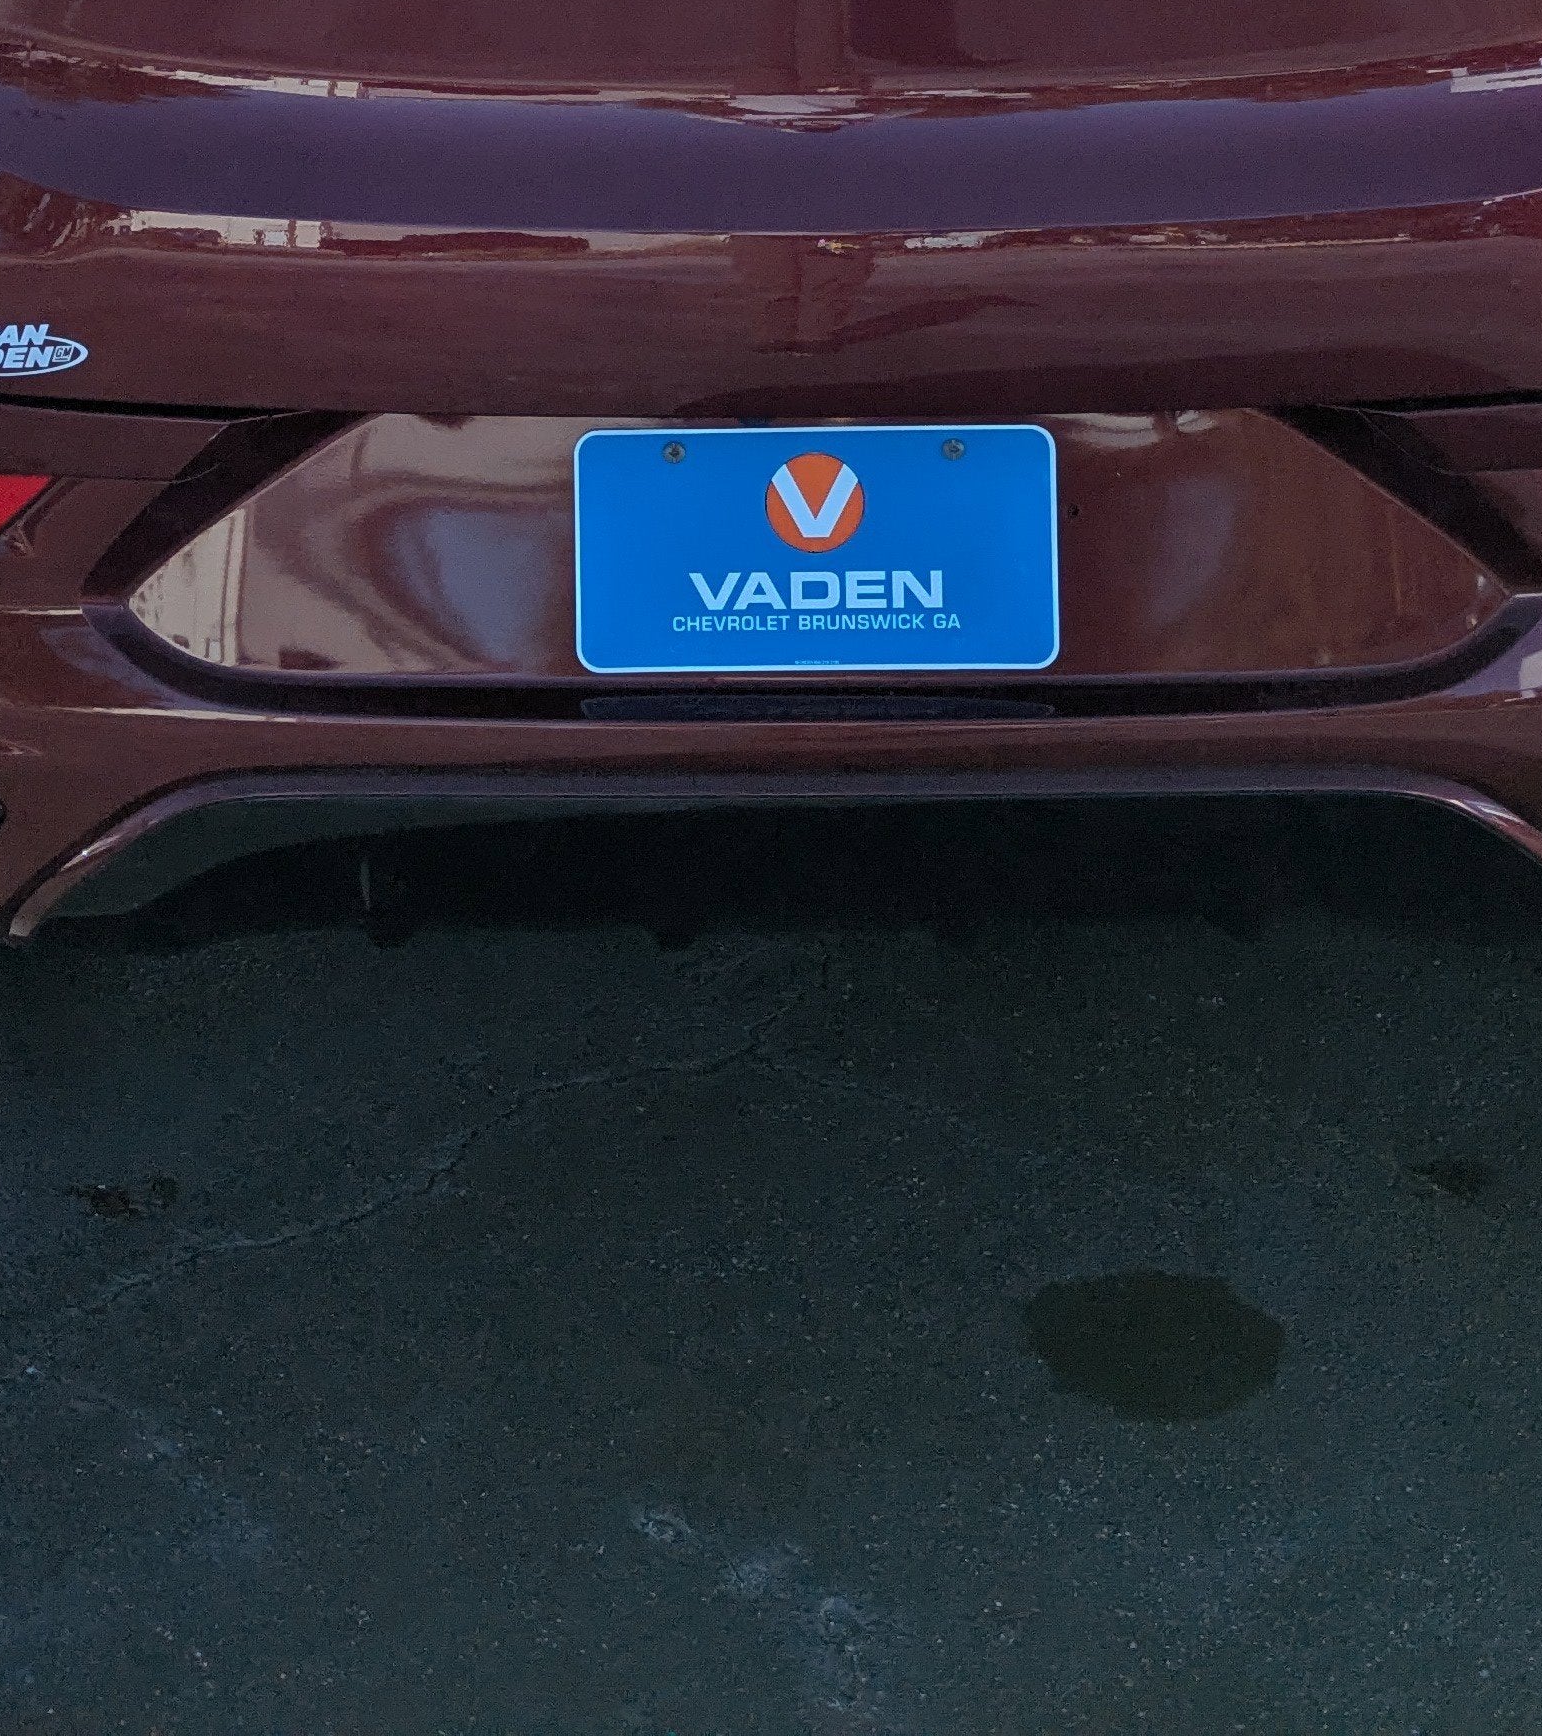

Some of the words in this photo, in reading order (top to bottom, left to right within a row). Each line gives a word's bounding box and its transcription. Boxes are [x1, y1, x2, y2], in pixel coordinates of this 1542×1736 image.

[771, 463, 860, 538] V
[688, 569, 944, 611] VADEN
[672, 614, 790, 632] CHEVROLET
[798, 613, 925, 631] BRUNSWICK
[933, 613, 961, 630] GA
